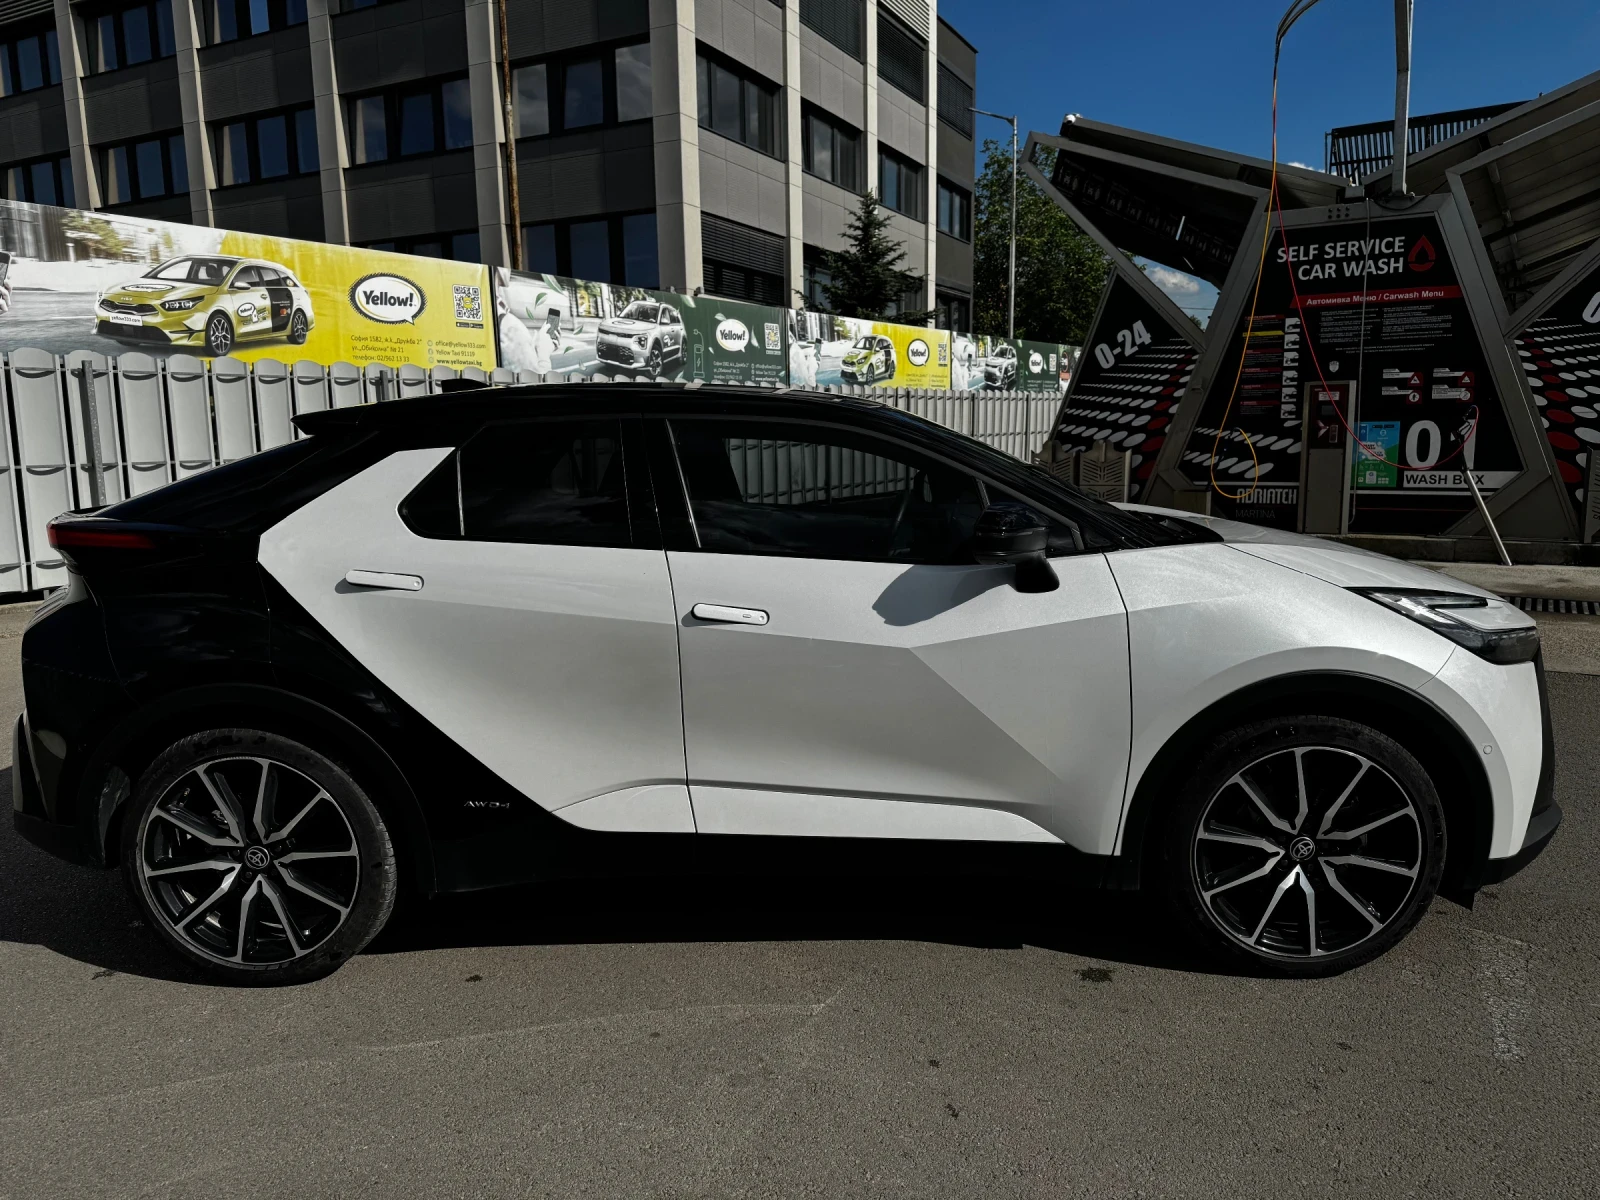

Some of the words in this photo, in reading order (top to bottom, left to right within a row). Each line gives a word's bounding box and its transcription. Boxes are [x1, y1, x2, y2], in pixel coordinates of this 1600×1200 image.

[1276, 244, 1319, 263] SELF
[1323, 236, 1406, 259] SERVICE
[1297, 263, 1337, 281] CAR
[1342, 257, 1404, 277] WASH
[362, 289, 415, 308] Yellow!
[1306, 296, 1351, 306] Автомивка
[1383, 291, 1419, 301] Carwash
[1421, 290, 1444, 298] Menu
[719, 329, 746, 341] Yellow!
[1094, 320, 1152, 369] 0-24
[1405, 418, 1477, 471] 01
[1405, 474, 1448, 485] WASH
